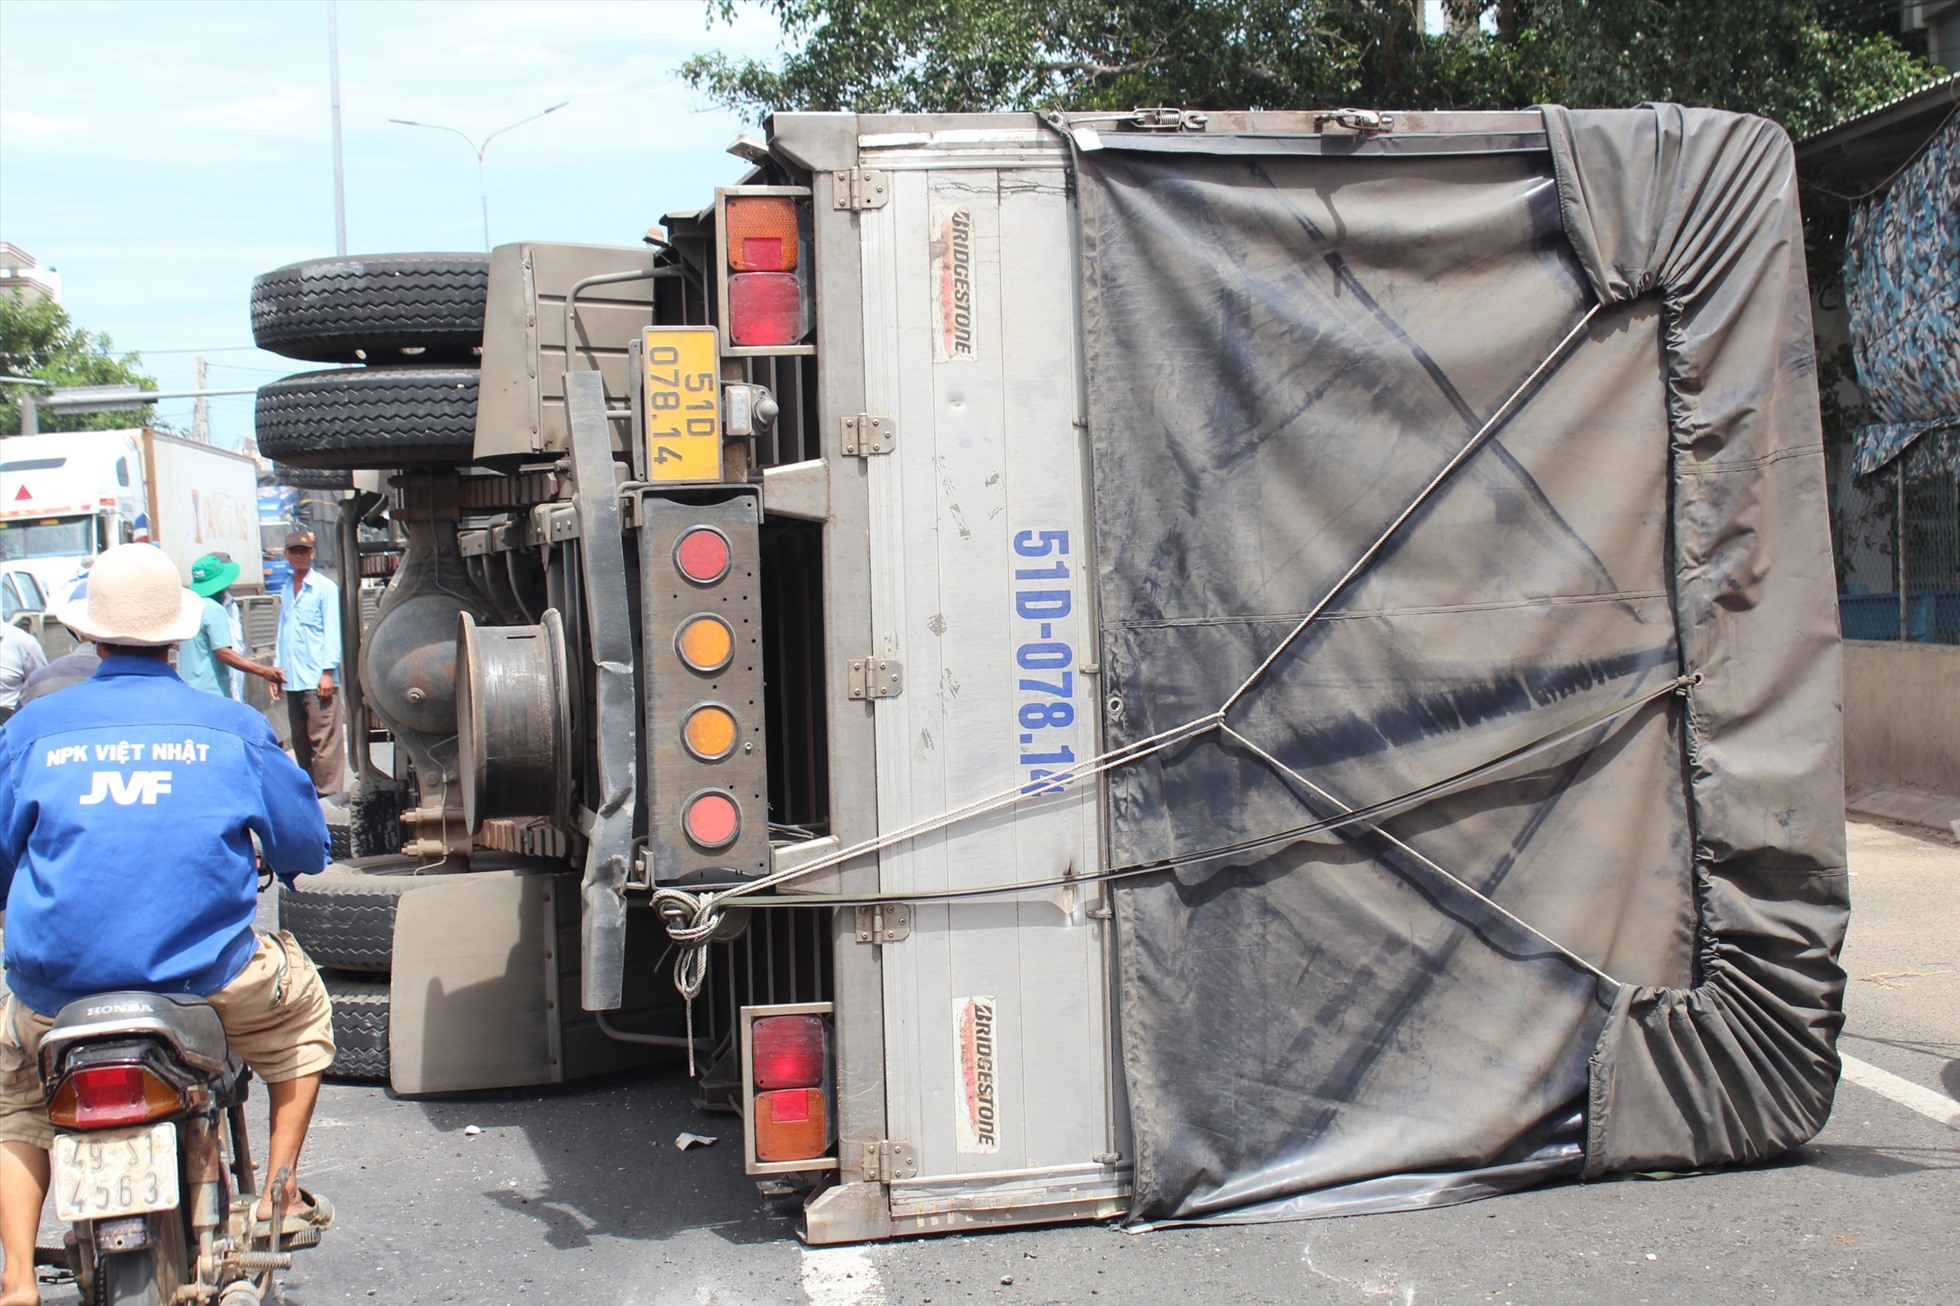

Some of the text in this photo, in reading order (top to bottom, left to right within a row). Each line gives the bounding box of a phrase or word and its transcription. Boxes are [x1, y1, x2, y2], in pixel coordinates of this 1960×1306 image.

[952, 211, 971, 354] BRIDGESTONE
[650, 346, 683, 465] 078.14
[684, 372, 715, 437] 51D
[46, 739, 210, 767] NPK VIỆT NHẬT
[79, 771, 172, 805] JVF
[86, 1003, 154, 1017] HONDA
[975, 1004, 994, 1146] BRIDGESTONE
[70, 1171, 159, 1213] 4563
